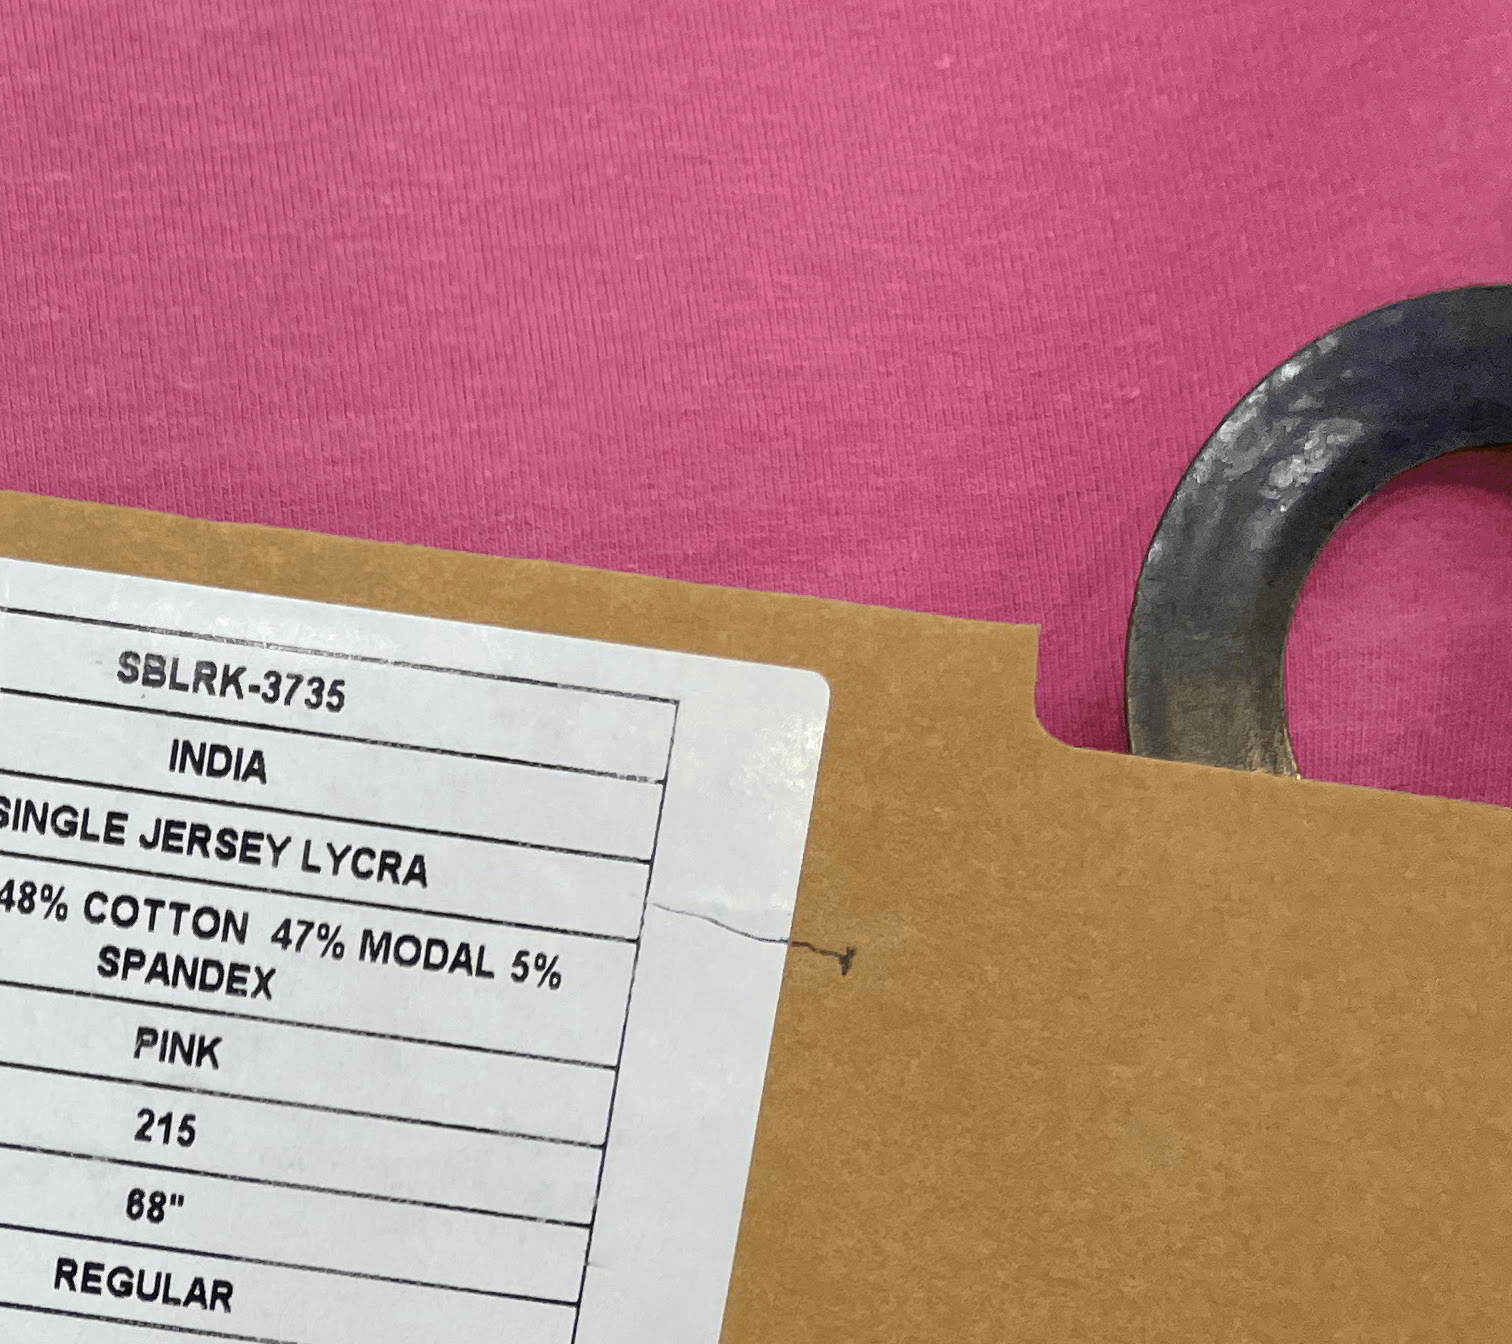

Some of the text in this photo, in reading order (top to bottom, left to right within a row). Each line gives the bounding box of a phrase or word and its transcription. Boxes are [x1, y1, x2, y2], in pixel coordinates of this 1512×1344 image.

[117, 651, 345, 712] SBLRK-3735
[169, 739, 266, 784] INDIA
[139, 818, 291, 867] JERSEY
[302, 840, 427, 888] LYCRA
[84, 891, 248, 944] COTTON
[271, 918, 344, 960] 47%
[359, 929, 494, 978] MODAL
[511, 950, 561, 989] 5%
[97, 945, 276, 1000] SPANDEX
[134, 1027, 222, 1069] PINK
[135, 1108, 196, 1147] 215
[55, 1257, 233, 1312] REGULAR
